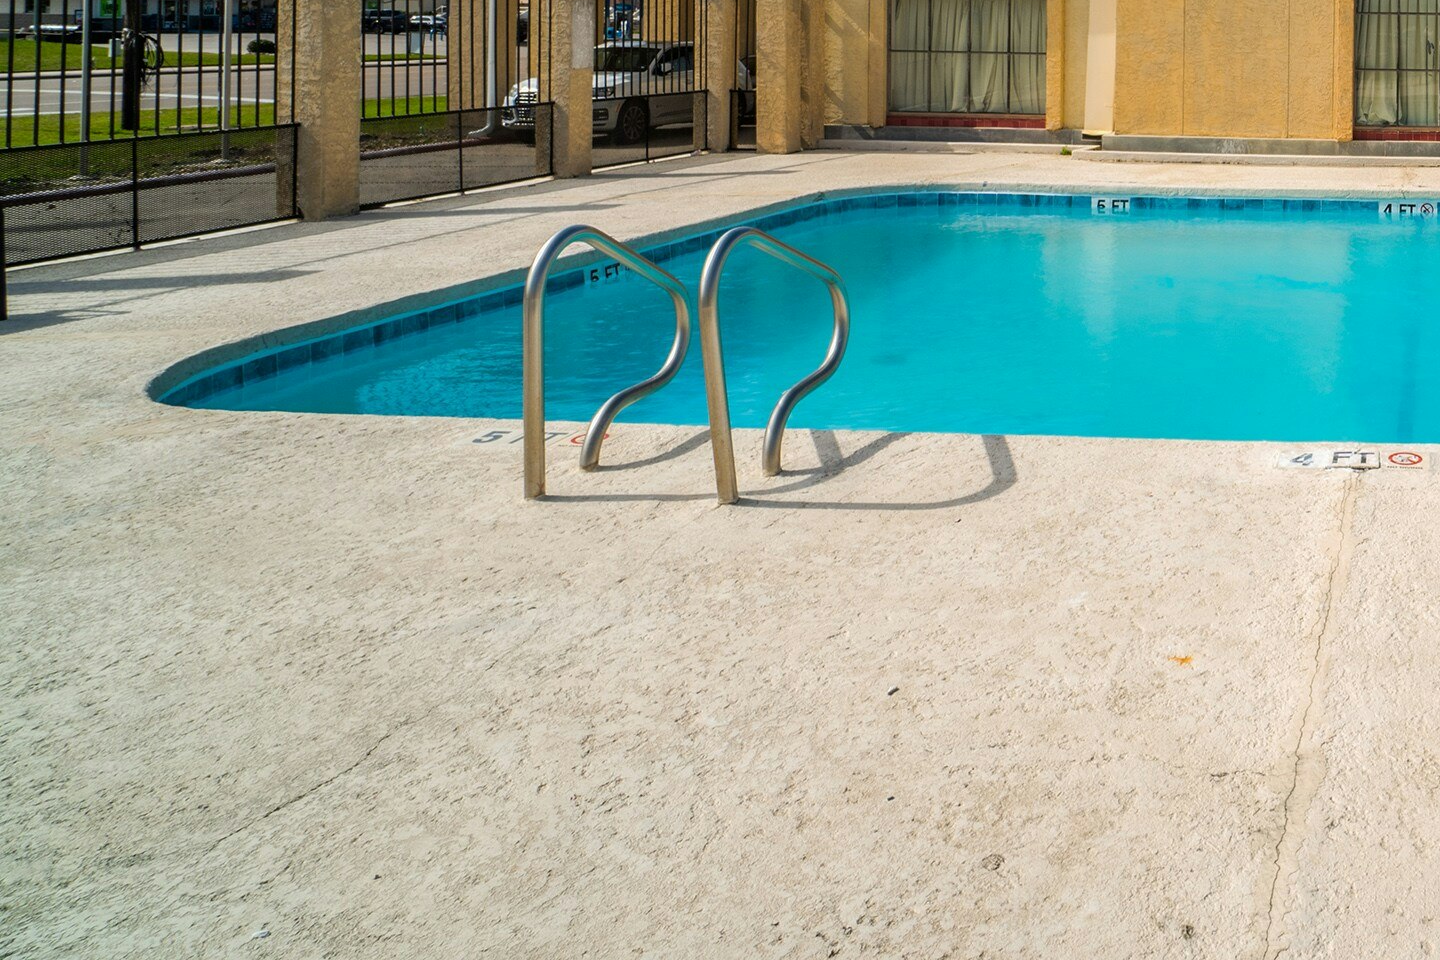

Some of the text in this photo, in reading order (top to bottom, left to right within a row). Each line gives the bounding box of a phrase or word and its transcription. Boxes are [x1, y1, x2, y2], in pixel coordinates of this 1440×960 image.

[1112, 200, 1129, 208] FT
[1384, 204, 1416, 213] 4 FT
[472, 431, 512, 444] 5
[1290, 451, 1375, 466] 4 FT
